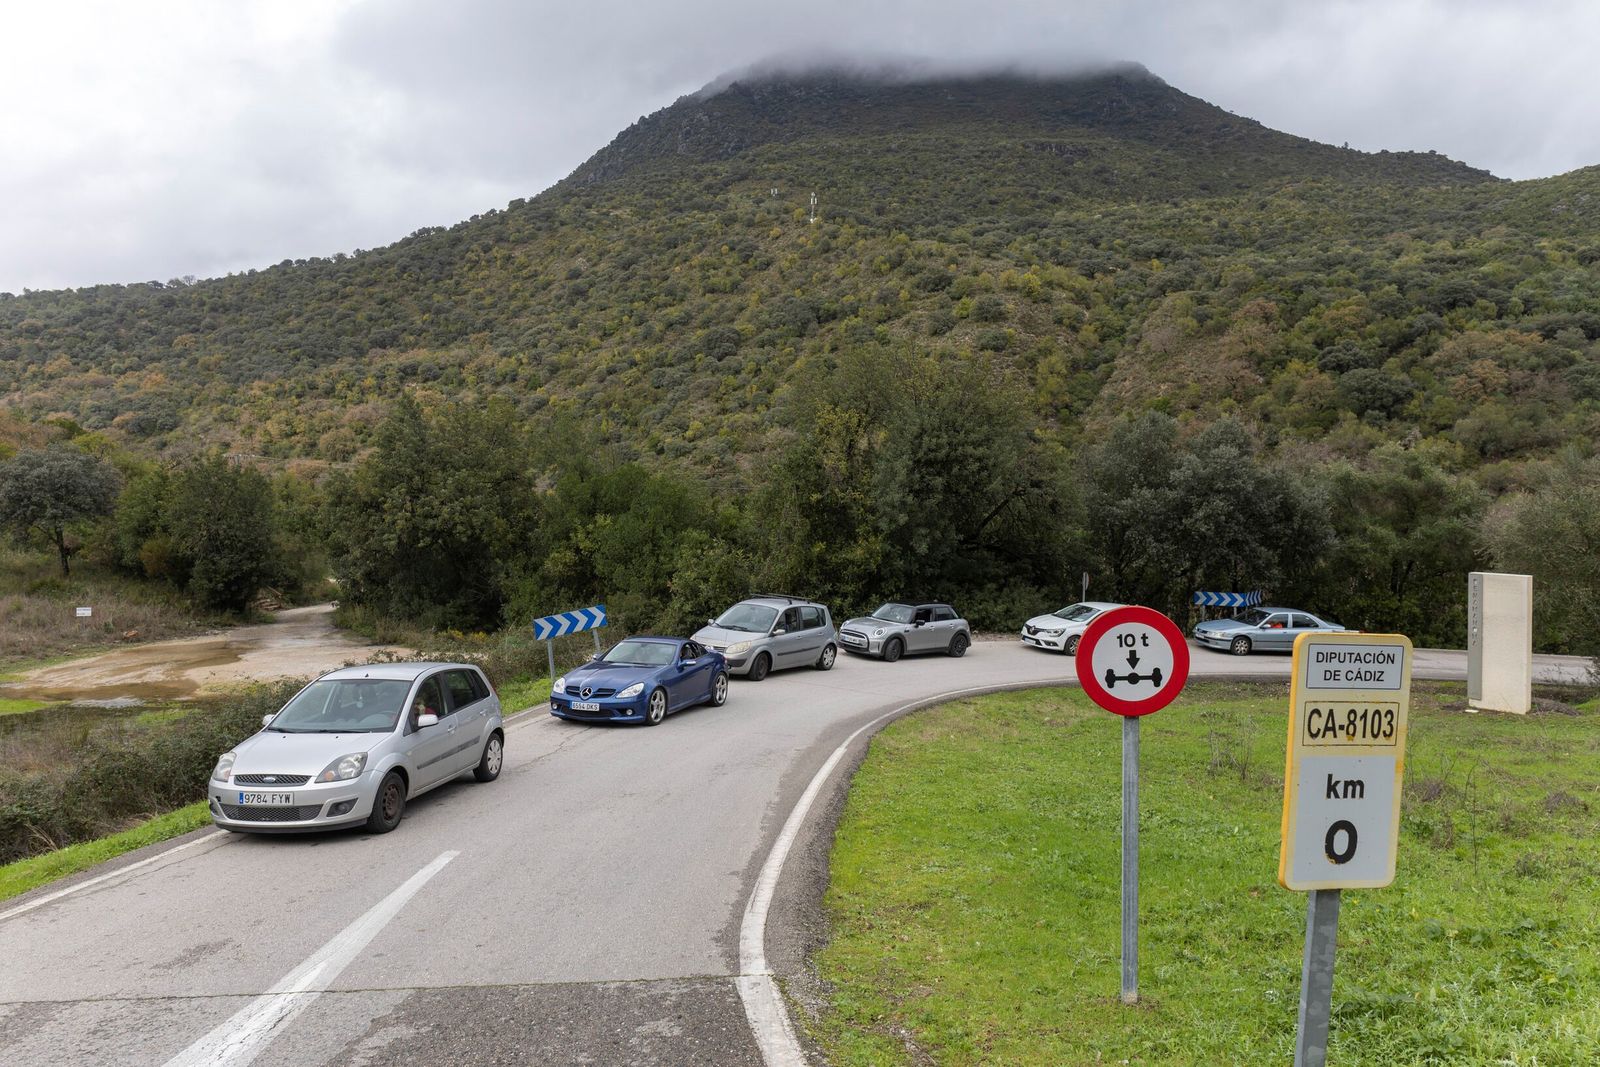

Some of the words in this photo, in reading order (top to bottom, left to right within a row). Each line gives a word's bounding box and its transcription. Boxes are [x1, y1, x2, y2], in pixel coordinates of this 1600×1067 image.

[1117, 633, 1136, 648] 10
[1141, 633, 1149, 647] t
[1316, 650, 1395, 665] DIPUTACIÓN
[1323, 670, 1341, 681] DE
[1345, 668, 1385, 682] CÁDIZ
[1307, 708, 1394, 740] CA-8103
[1326, 773, 1364, 799] km
[244, 793, 268, 803] 9784
[272, 793, 291, 803] FYW
[1325, 819, 1358, 865] 0
